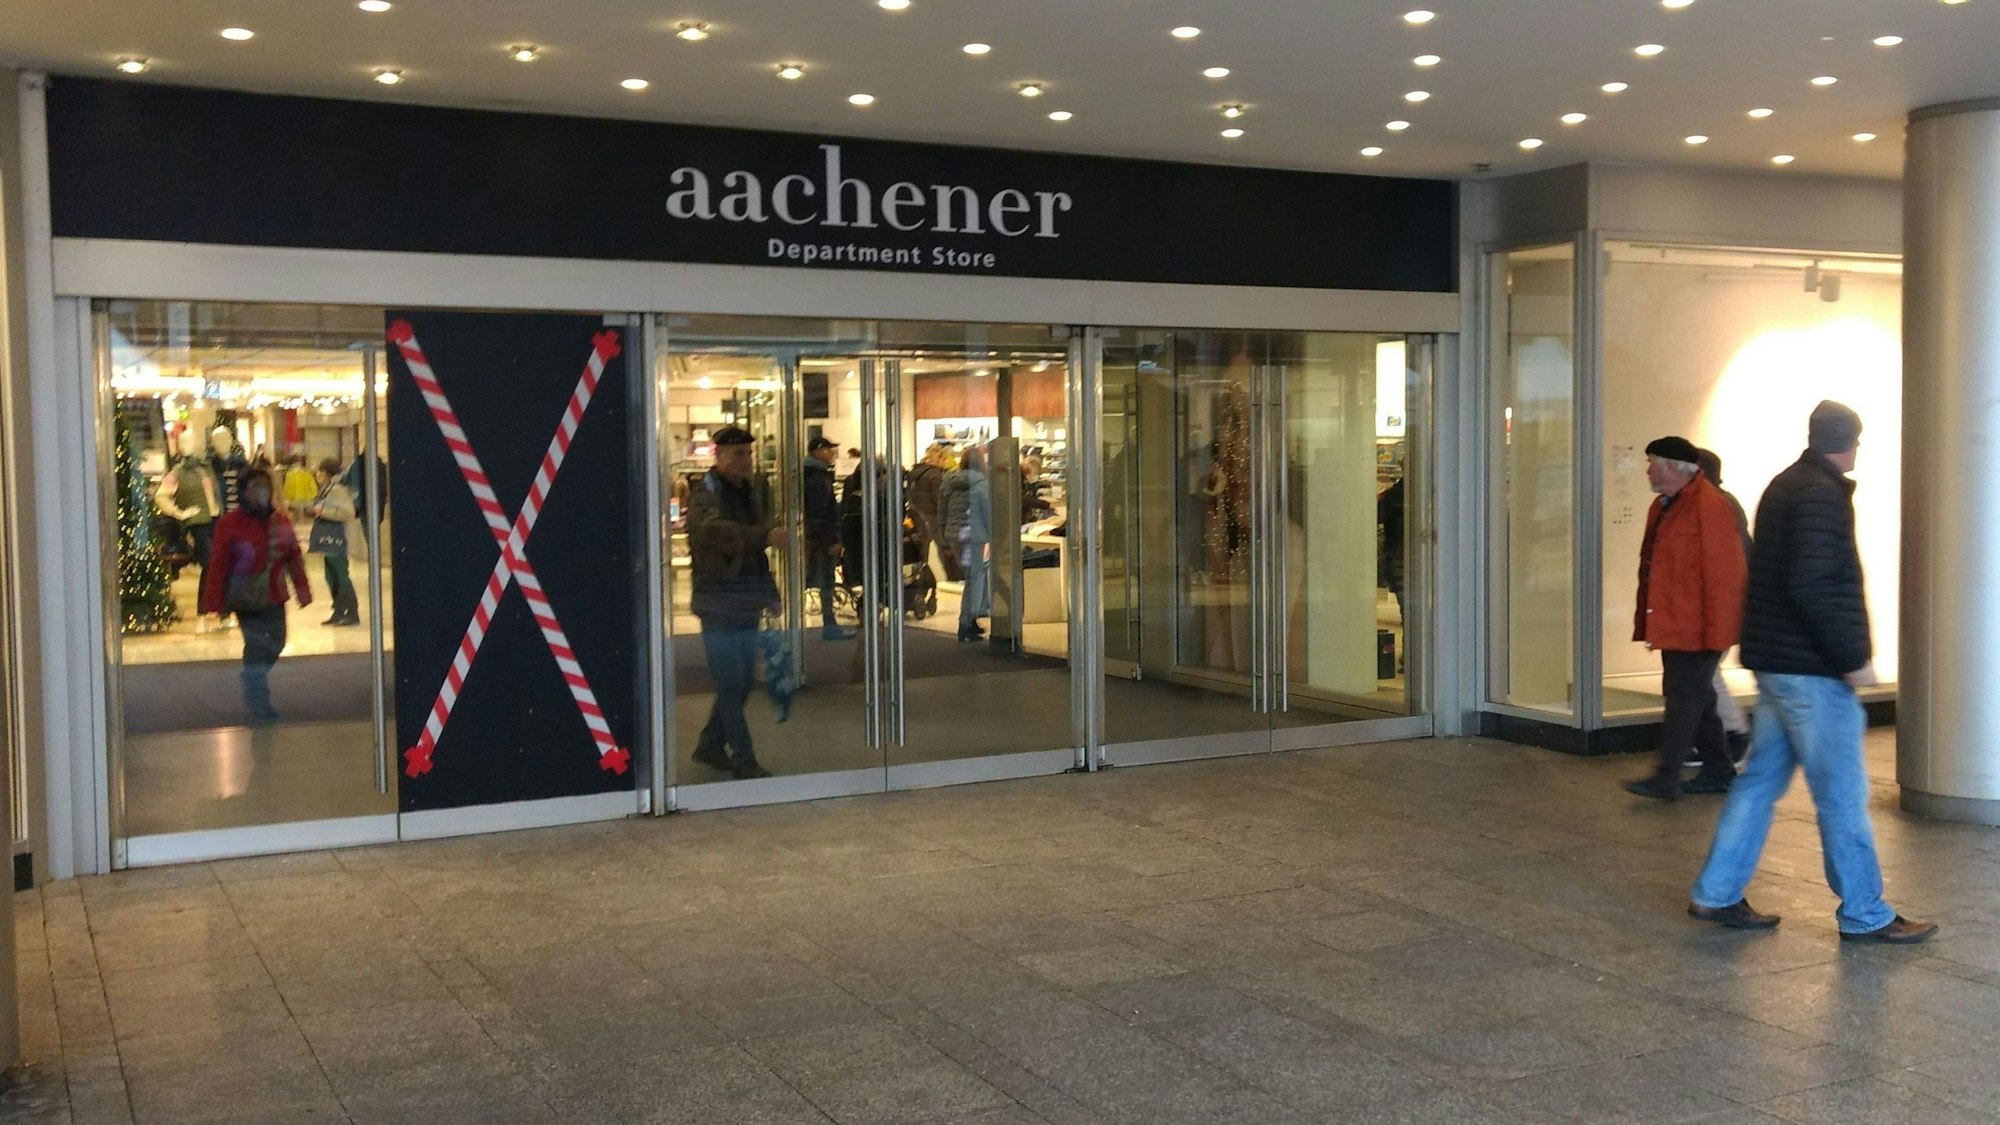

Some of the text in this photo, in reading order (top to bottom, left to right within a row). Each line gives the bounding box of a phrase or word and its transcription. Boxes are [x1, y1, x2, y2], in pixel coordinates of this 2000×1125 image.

[665, 143, 1073, 239] aachener
[767, 238, 997, 268] Department Store
